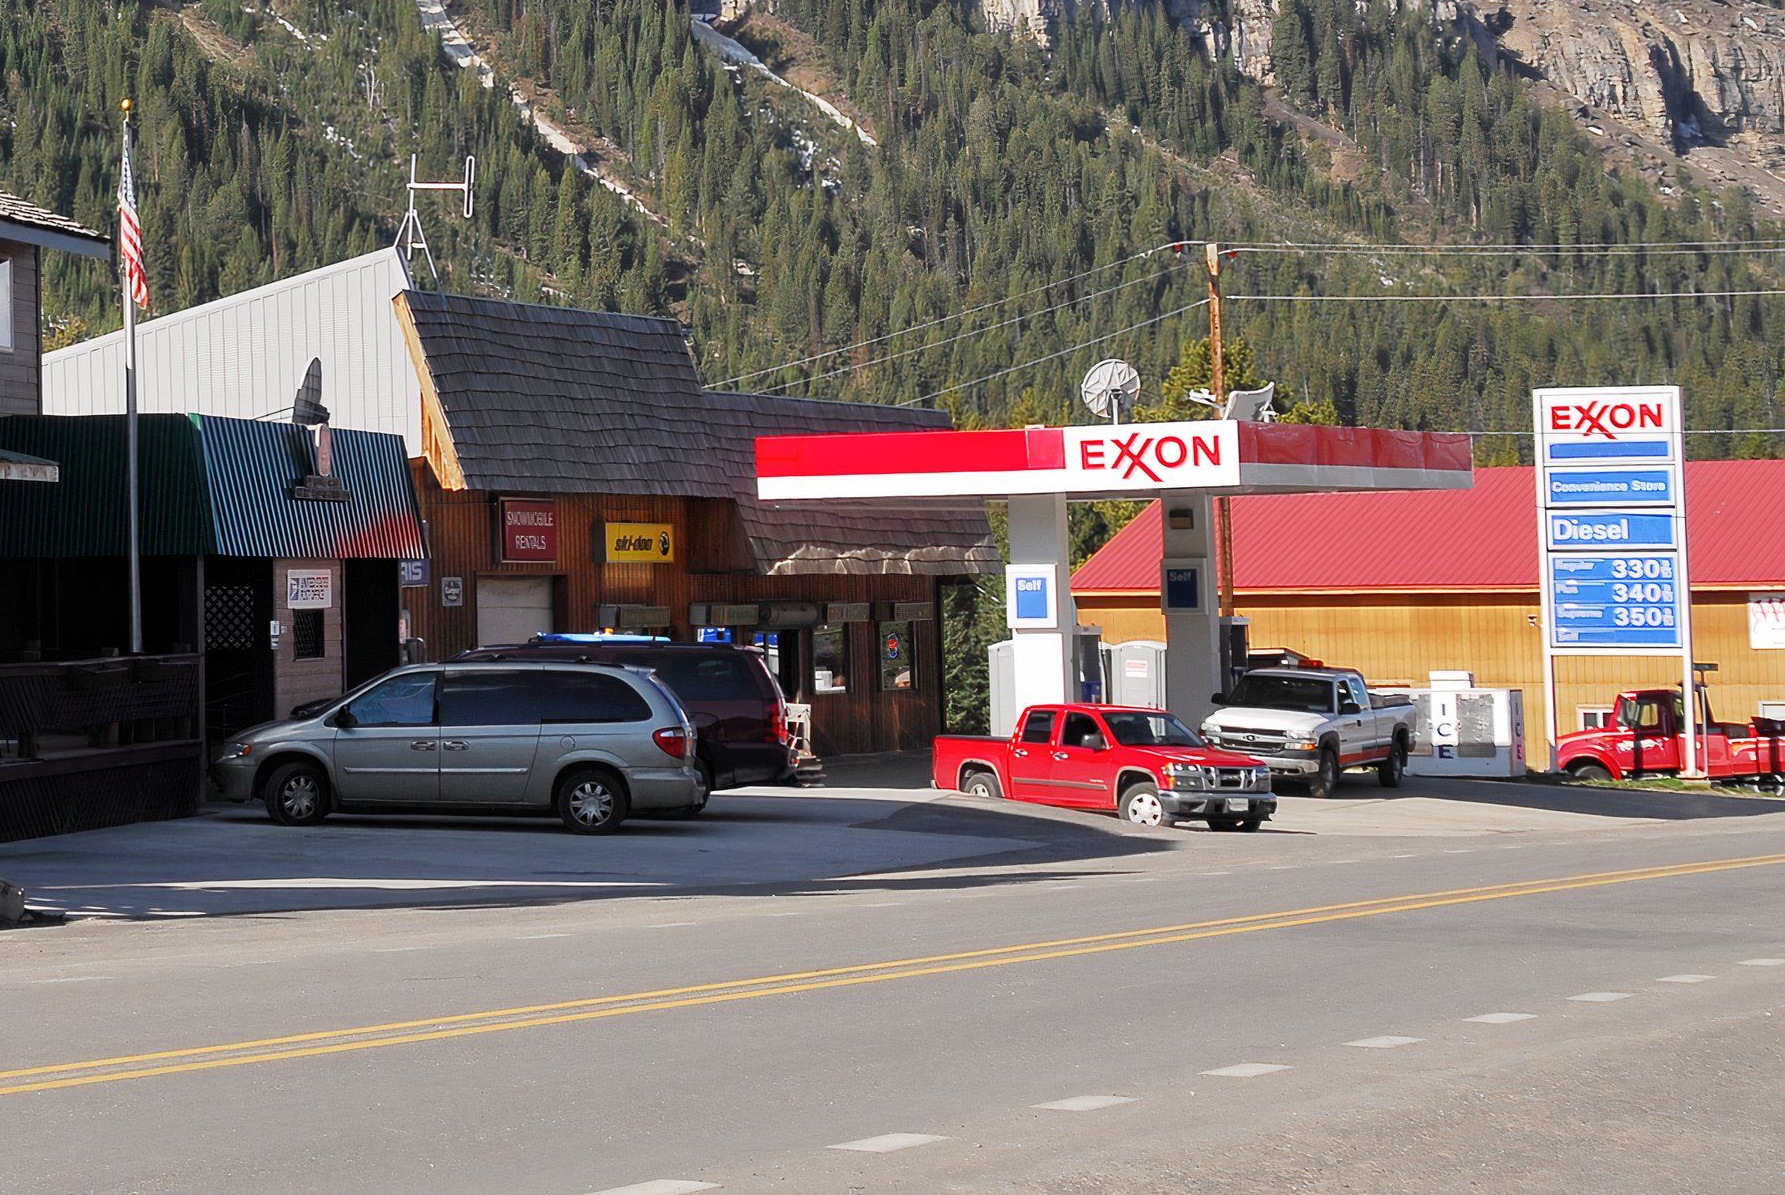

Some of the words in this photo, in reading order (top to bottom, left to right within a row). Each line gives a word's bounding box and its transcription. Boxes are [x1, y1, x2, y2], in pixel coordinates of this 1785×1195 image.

[1551, 401, 1663, 440] EXXON
[1080, 432, 1221, 483] EXXON
[1551, 481, 1628, 493] Convenience
[1631, 479, 1666, 492] Store
[1553, 518, 1629, 541] Diesel
[516, 535, 547, 550] RENTALS
[1017, 579, 1042, 591] Self
[1169, 571, 1191, 582] Self
[1437, 703, 1454, 759] ICE
[1514, 701, 1523, 760] ICE
